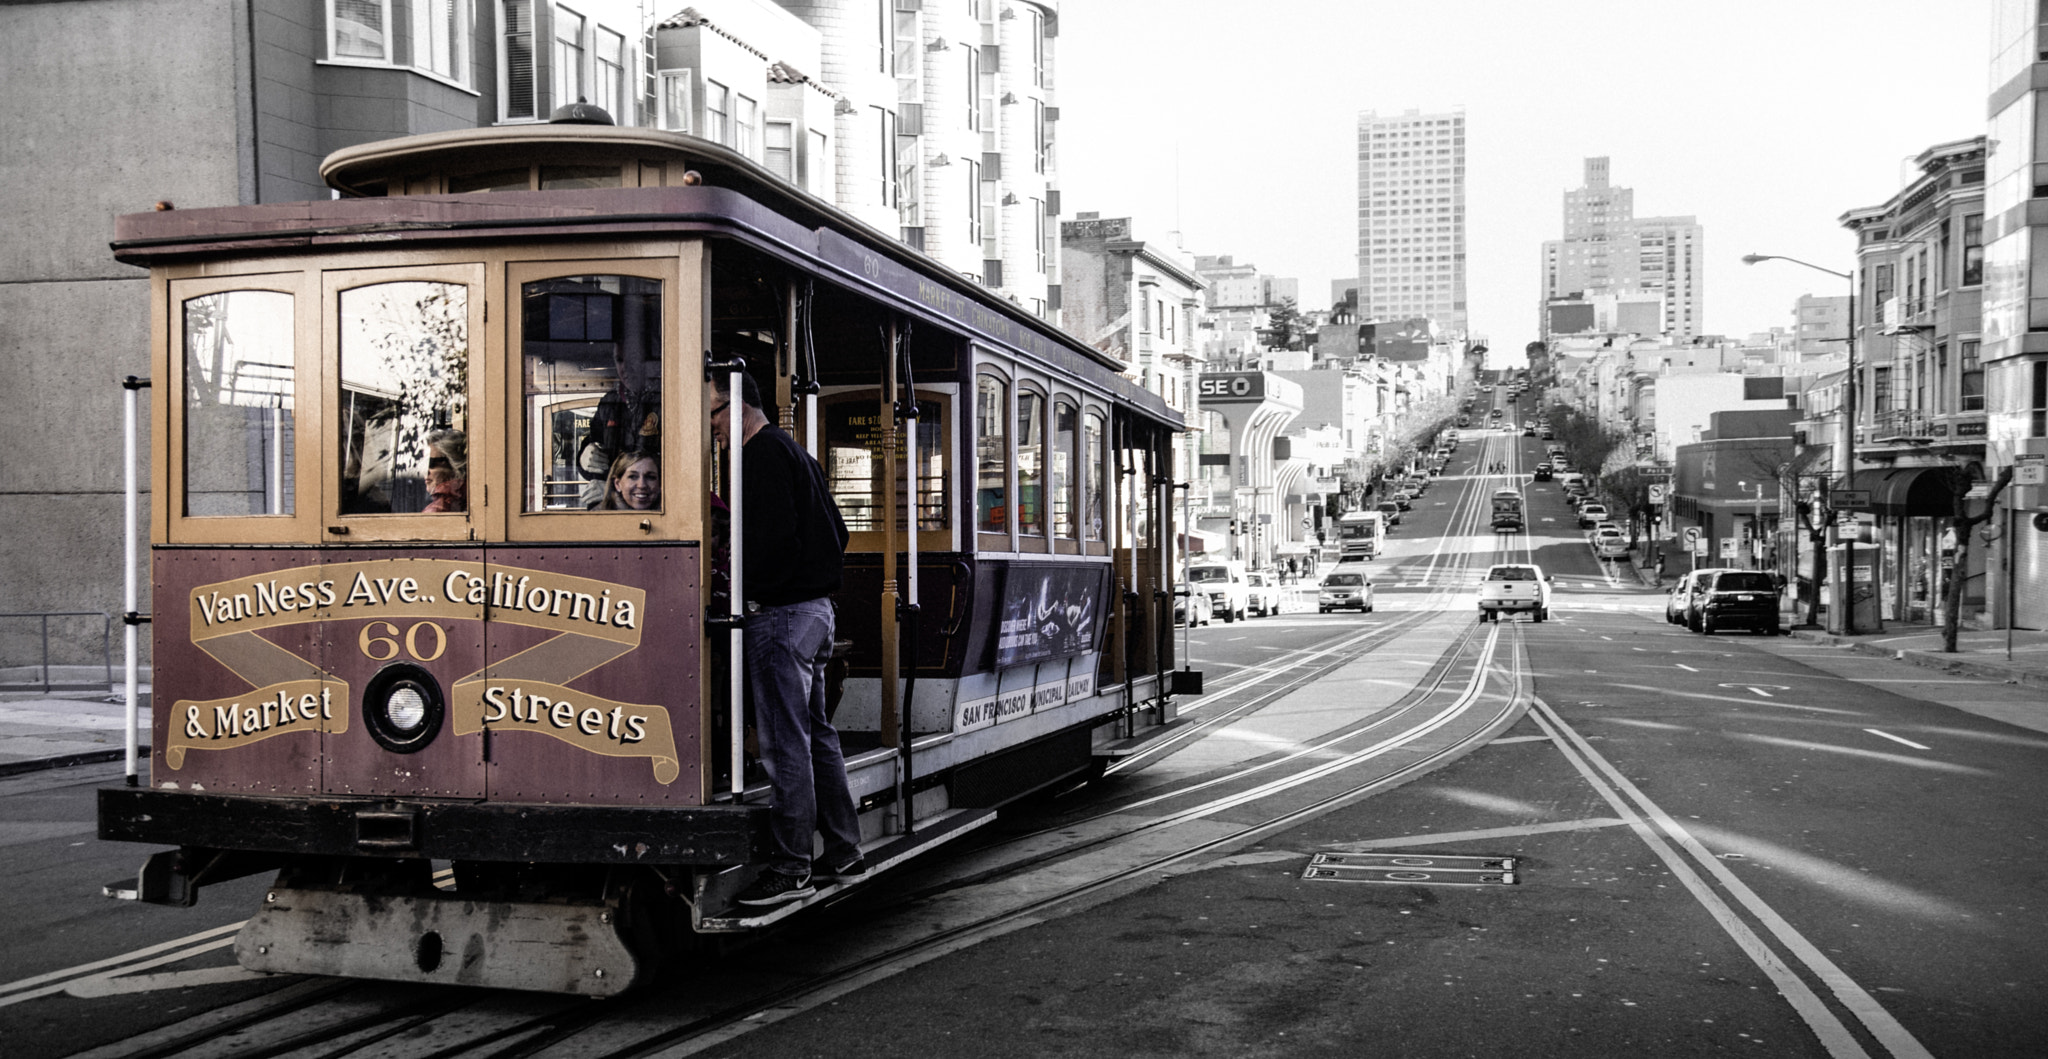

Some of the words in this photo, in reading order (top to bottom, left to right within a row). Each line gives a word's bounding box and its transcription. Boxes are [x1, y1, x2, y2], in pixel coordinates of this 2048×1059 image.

[864, 255, 879, 278] 60
[918, 281, 950, 314] MARKET
[574, 418, 590, 428] FARE
[848, 416, 866, 425] FARE
[197, 590, 253, 626] Van
[253, 576, 337, 615] Ness
[444, 569, 639, 629] California
[358, 620, 447, 662] 60
[185, 705, 208, 740] &
[215, 687, 333, 740] Market
[483, 685, 649, 744] Streets
[962, 704, 981, 727] SAN
[983, 693, 1026, 721] FRANCISCO
